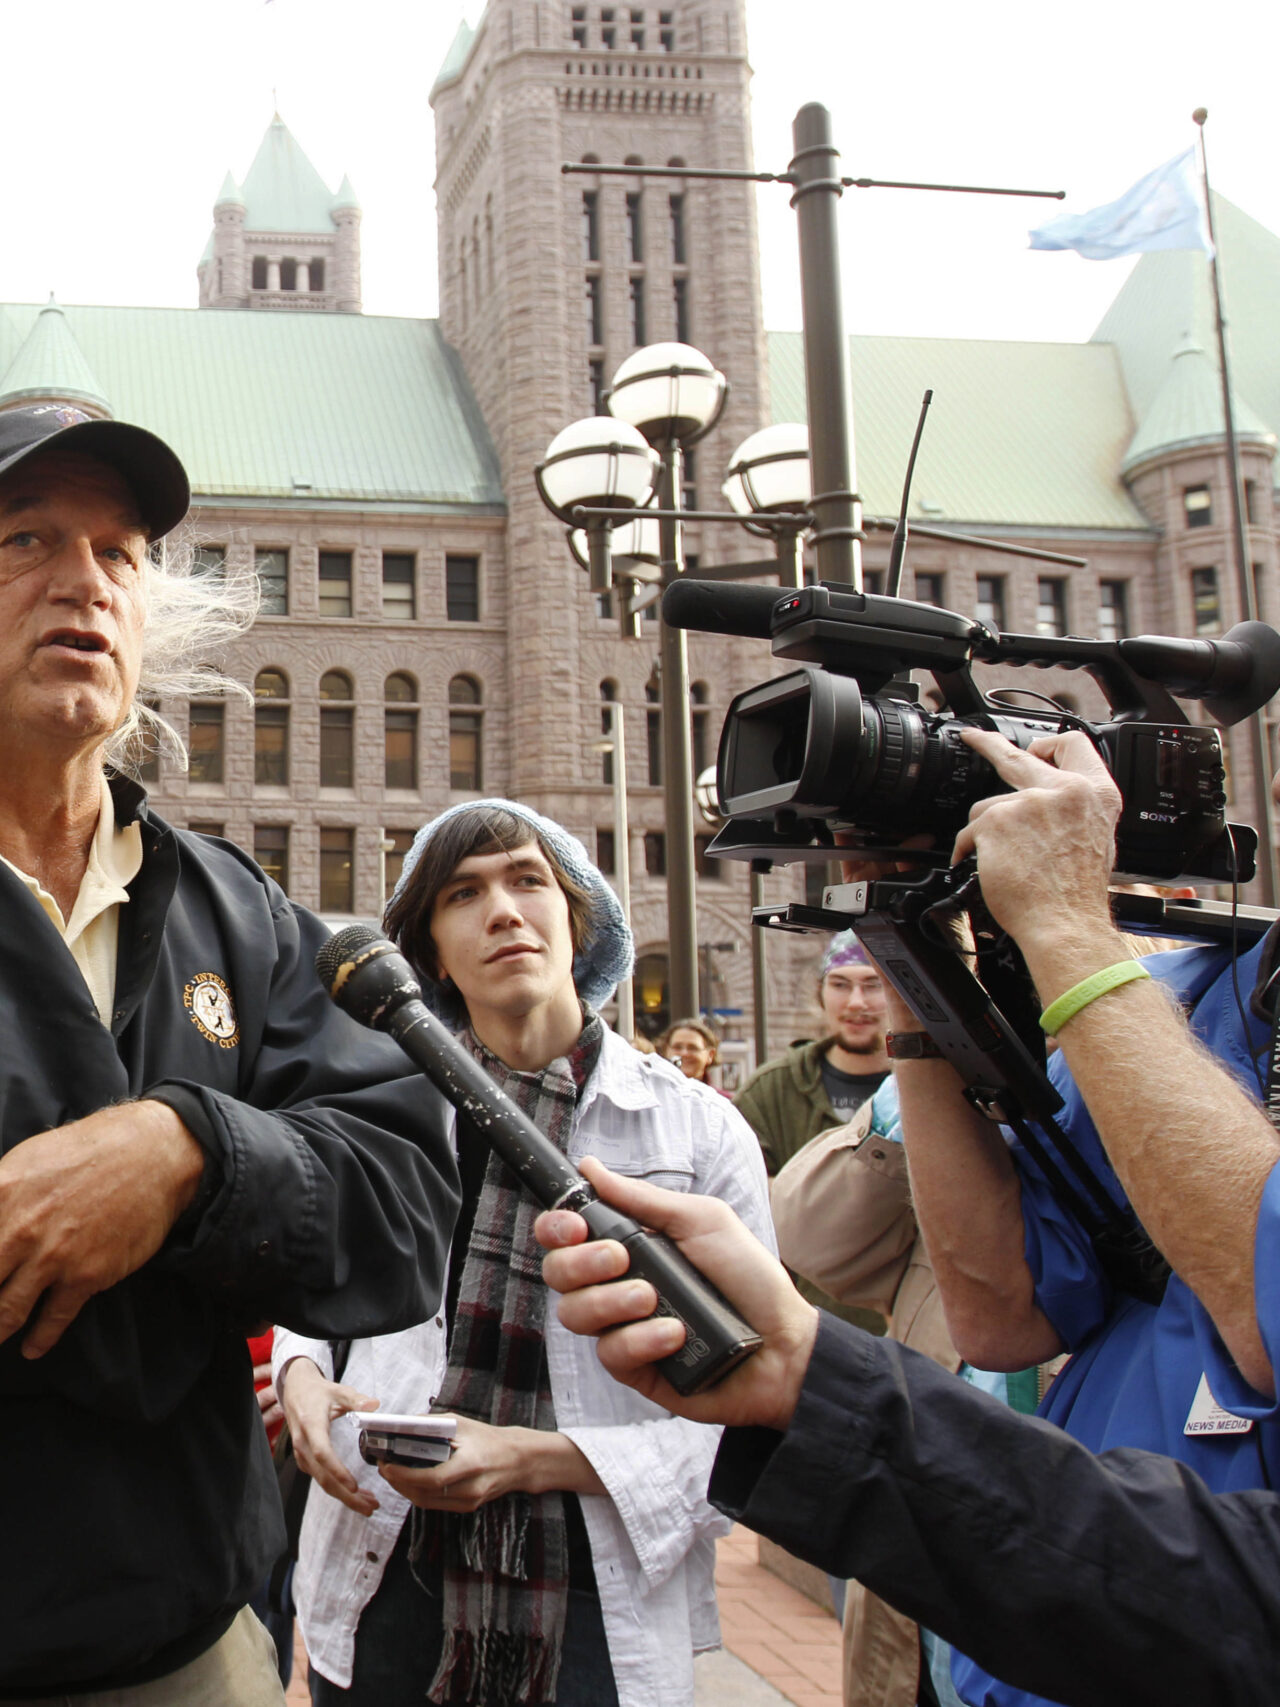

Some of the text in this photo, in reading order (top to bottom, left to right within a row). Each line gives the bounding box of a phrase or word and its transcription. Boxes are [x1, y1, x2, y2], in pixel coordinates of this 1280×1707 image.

[1140, 811, 1177, 824] SONY
[183, 984, 195, 1008] TPC
[1186, 1420, 1248, 1431] NEWS MEDIA
